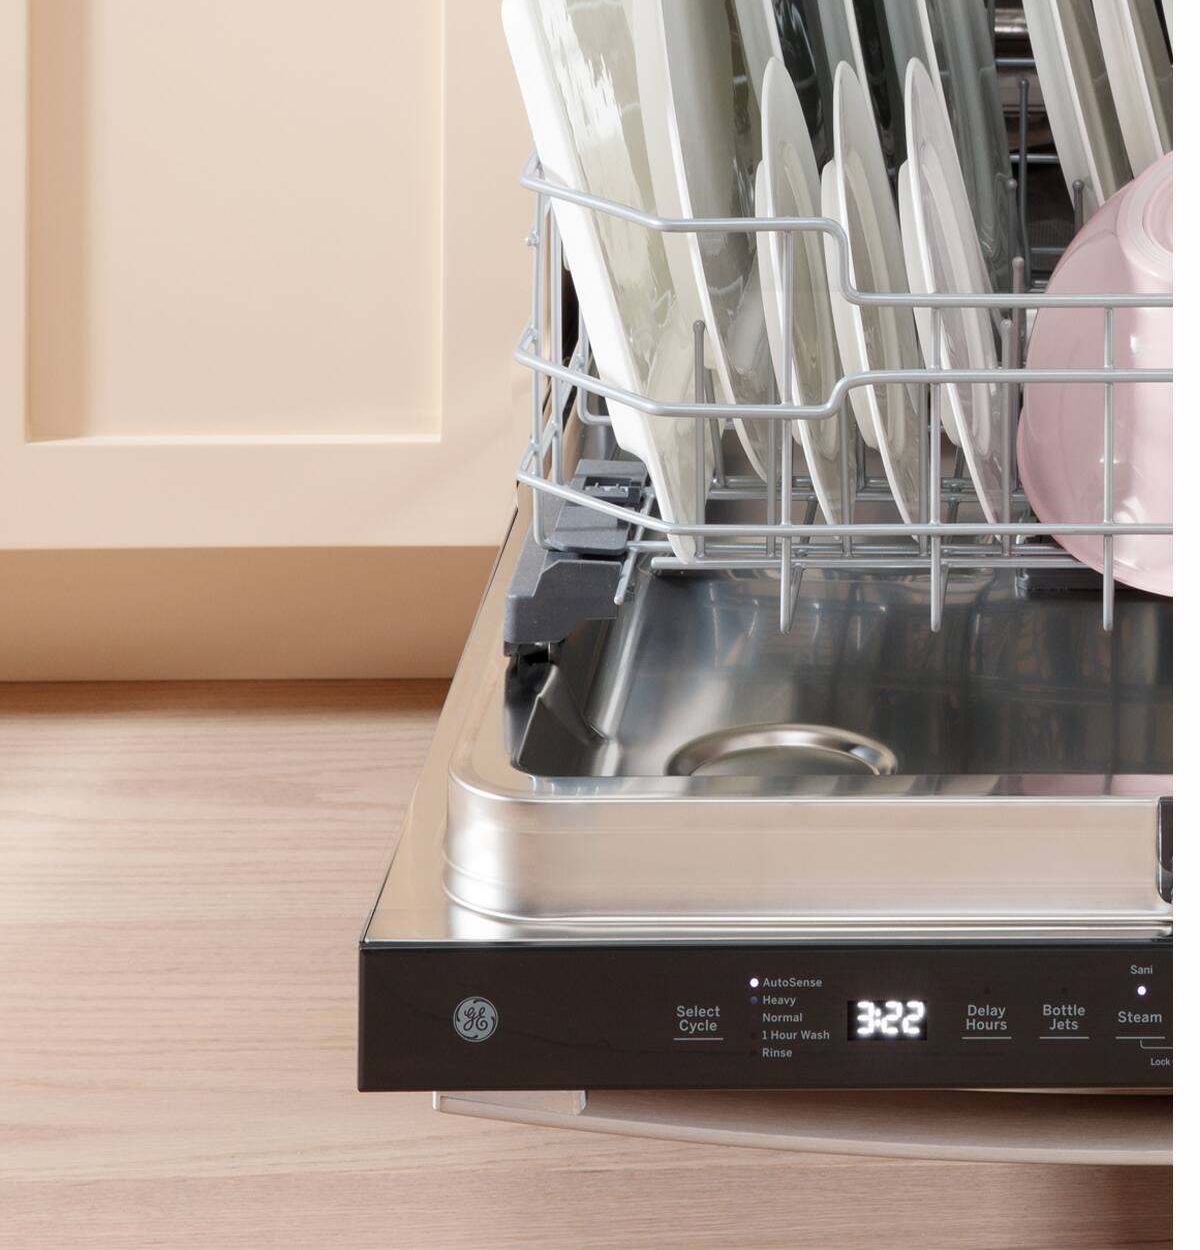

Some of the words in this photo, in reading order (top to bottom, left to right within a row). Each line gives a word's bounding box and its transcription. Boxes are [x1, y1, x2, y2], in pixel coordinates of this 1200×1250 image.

[1130, 964, 1153, 975] Sani
[762, 977, 823, 988] AutoSense
[762, 995, 796, 1006] Heavy
[676, 1005, 721, 1018] Select
[967, 1004, 1006, 1019] Delay
[1042, 1004, 1086, 1017] Bottle
[762, 1012, 803, 1023] Normal
[857, 1000, 925, 1035] 3:22
[1117, 1010, 1163, 1024] Steam
[679, 1019, 718, 1033] Cycle
[966, 1019, 1008, 1031] Hours
[1049, 1018, 1079, 1031] Jets
[762, 1030, 768, 1040] 1
[770, 1029, 798, 1040] Hour
[800, 1029, 830, 1040] Wash
[762, 1047, 793, 1058] Rinse
[1150, 1057, 1171, 1066] Lock
